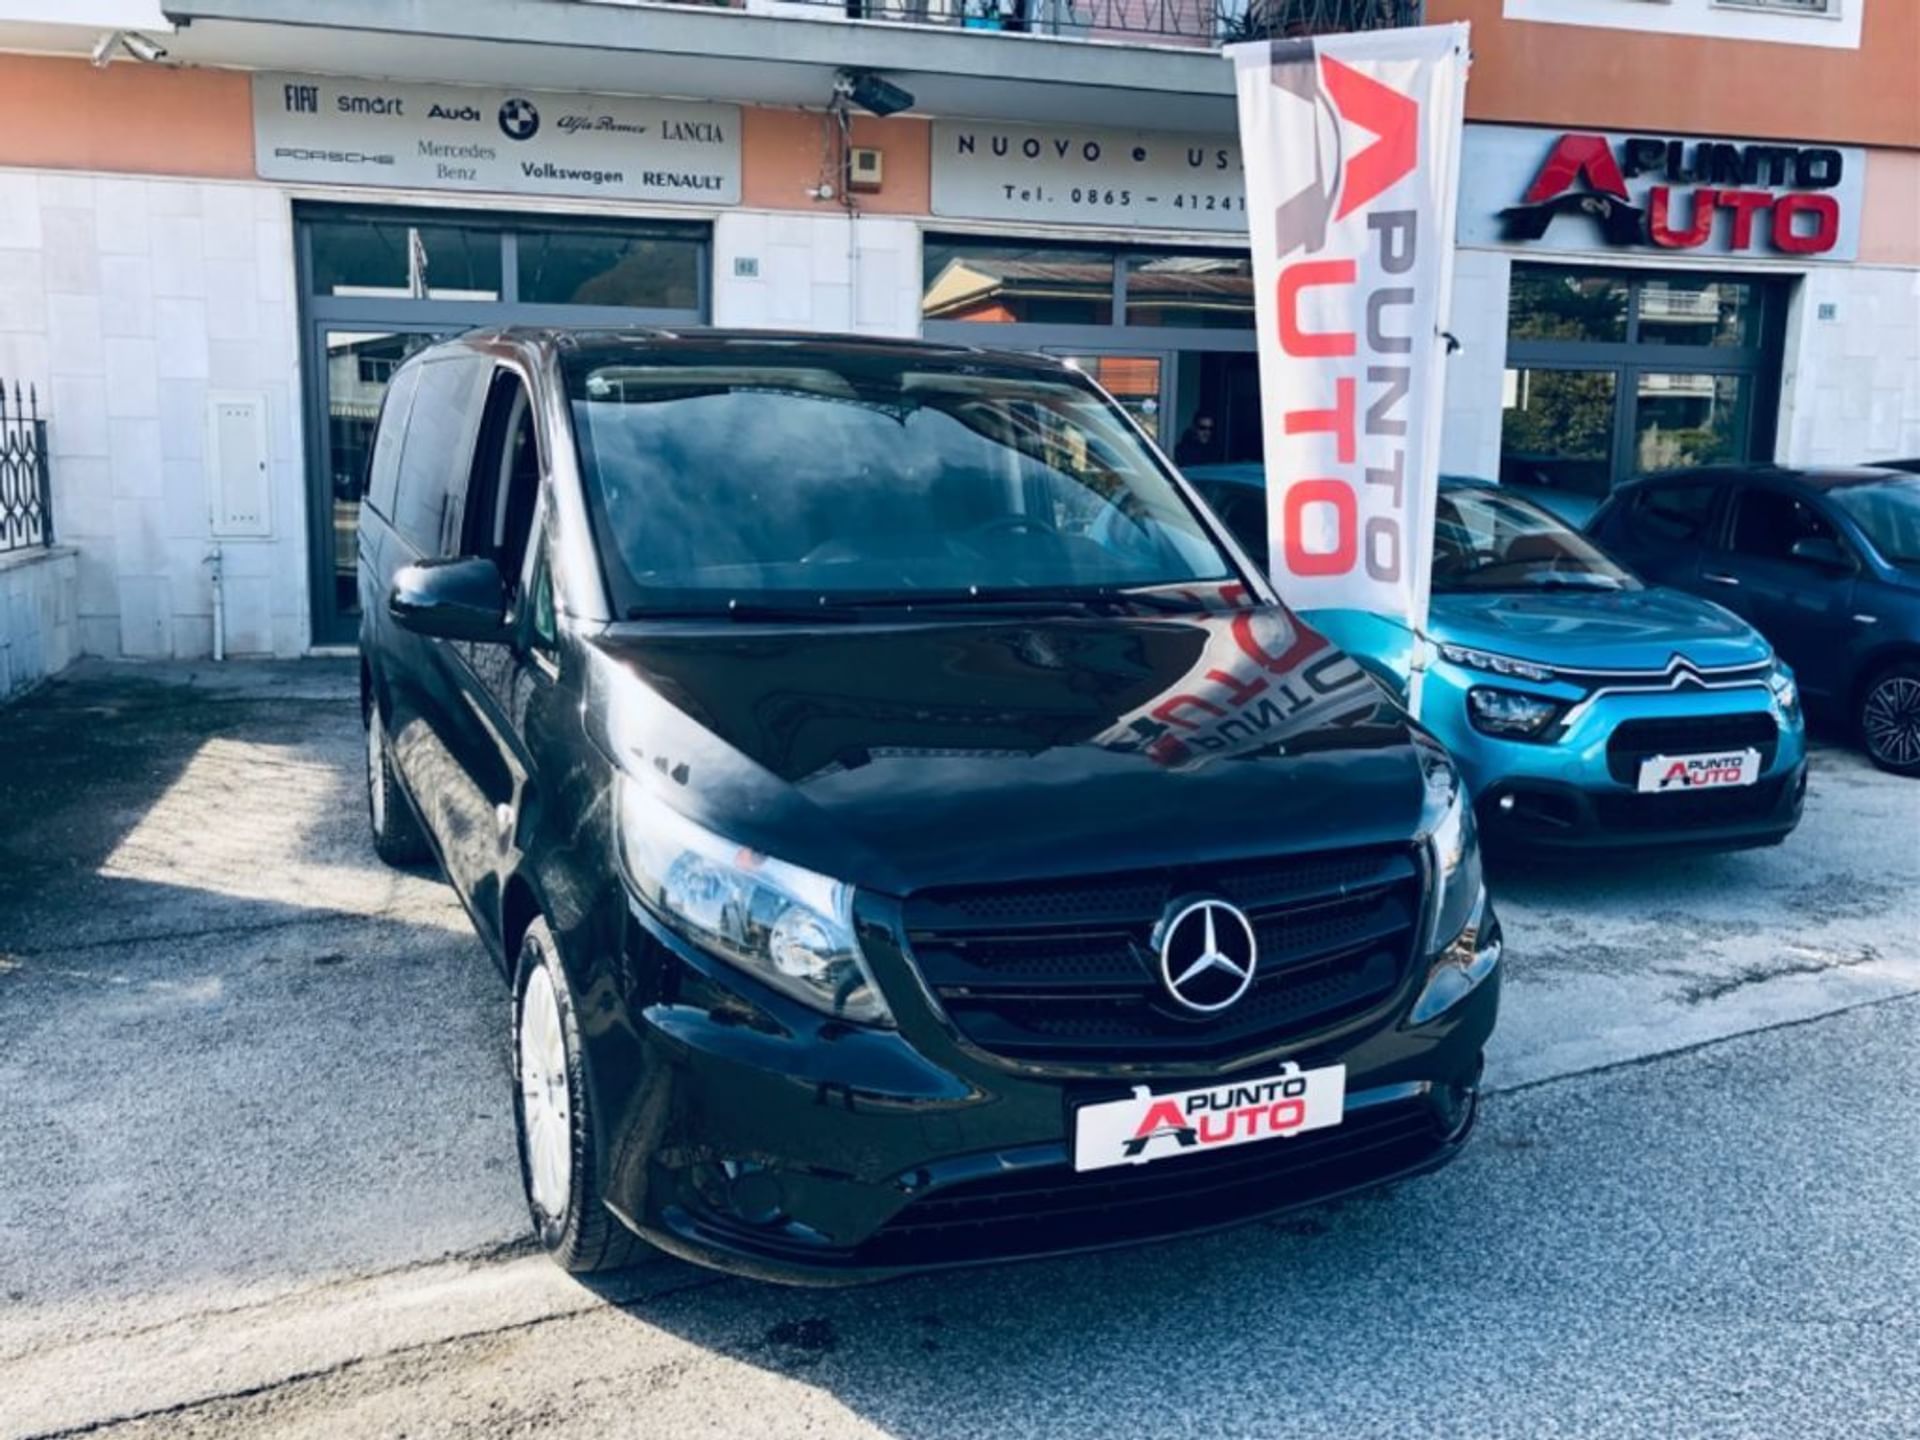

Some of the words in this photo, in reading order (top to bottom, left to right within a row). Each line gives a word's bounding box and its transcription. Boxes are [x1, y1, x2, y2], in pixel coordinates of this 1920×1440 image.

[284, 84, 319, 114] FIAT
[336, 95, 404, 116] smart
[427, 104, 481, 122] Audi
[556, 115, 592, 135] Alfa
[661, 119, 725, 144] LANCIA
[274, 147, 395, 166] PORSCHE
[417, 139, 496, 161] Mercedes
[958, 134, 1101, 163] NUOVO
[1132, 146, 1147, 162] e
[1188, 147, 1245, 171] US
[436, 162, 478, 182] Benz
[521, 161, 624, 185] Volkswagen
[1622, 138, 1843, 189] PUNTO
[642, 171, 724, 191] RENAULT
[1003, 184, 1054, 202] Tel.
[1071, 187, 1131, 206] 0865
[1364, 209, 1419, 584] PUNTO
[1686, 756, 1743, 770] PUNTO
[1185, 1077, 1307, 1115] PUNTO
